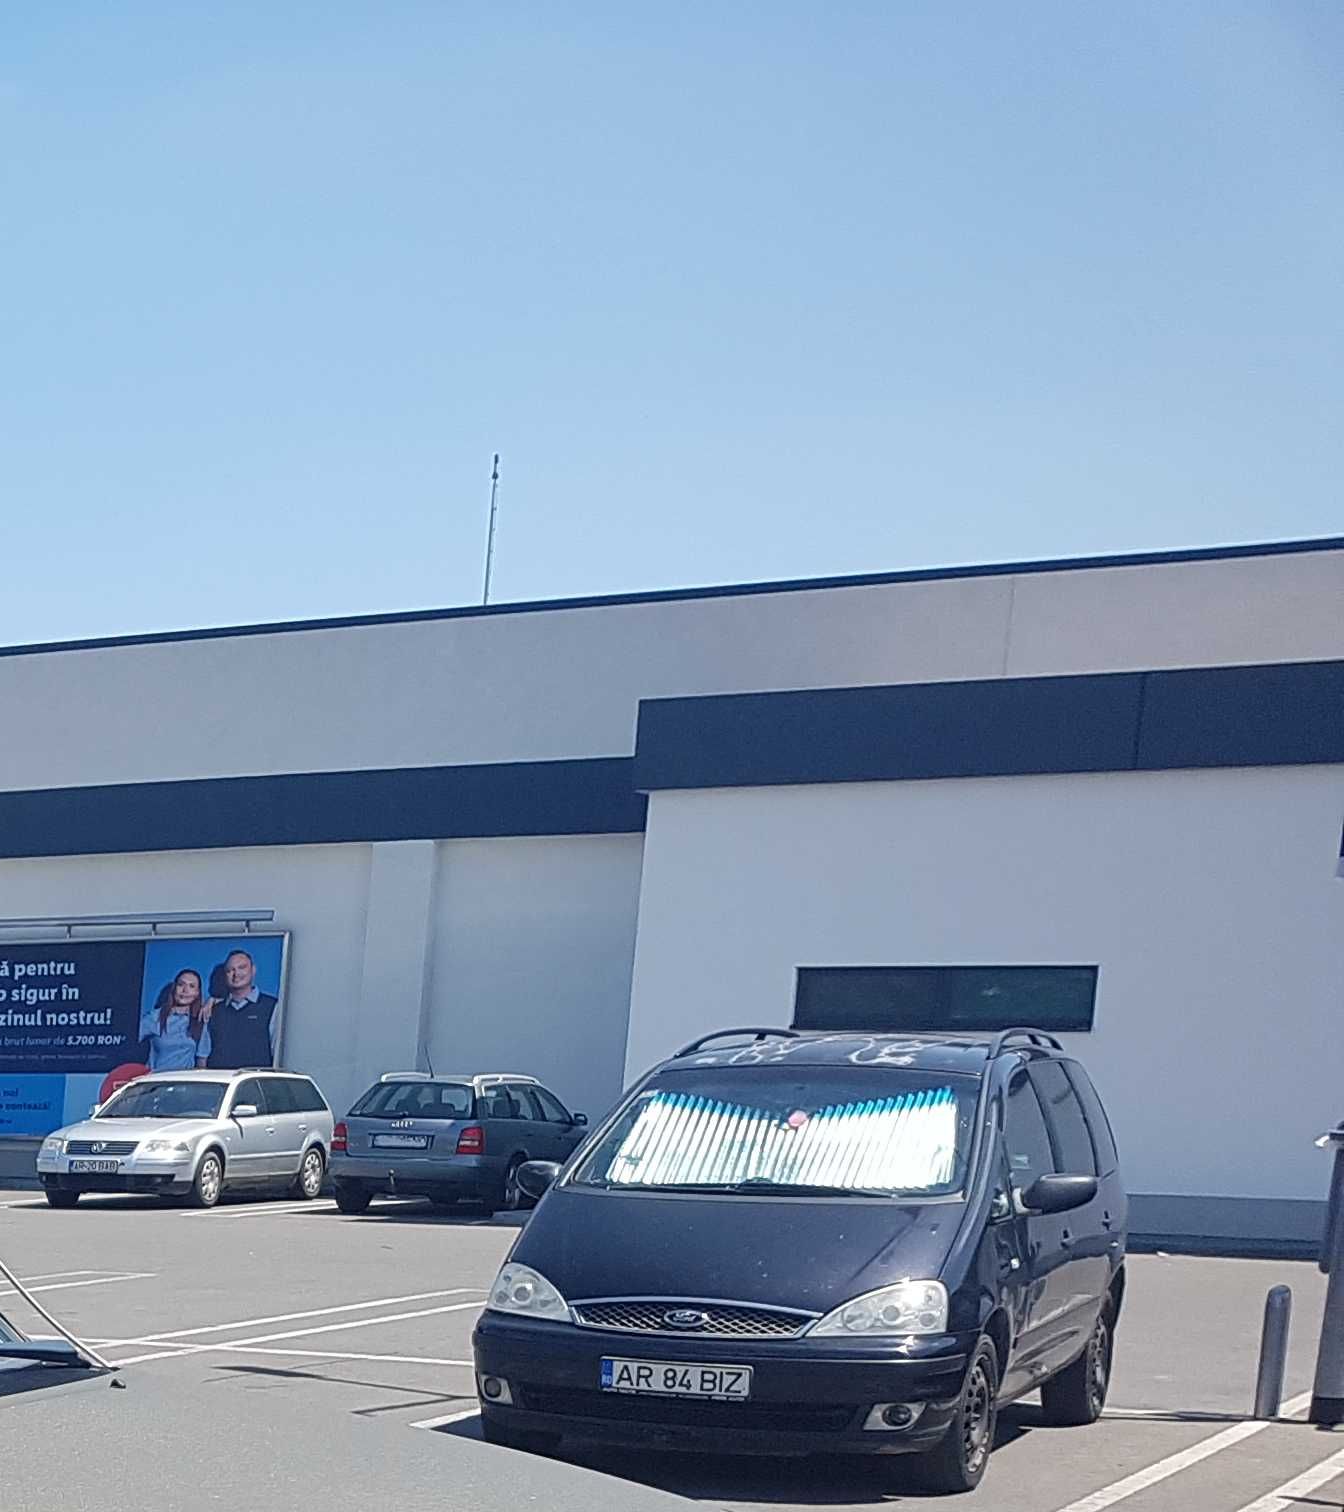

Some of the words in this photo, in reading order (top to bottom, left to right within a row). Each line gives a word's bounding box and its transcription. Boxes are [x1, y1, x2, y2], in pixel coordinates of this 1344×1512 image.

[14, 961, 76, 980] pentru
[10, 984, 59, 1005] sigur
[61, 984, 79, 1001] în
[46, 1008, 112, 1026] nostru!
[616, 1364, 654, 1388] AR
[663, 1368, 692, 1391] 84
[700, 1371, 743, 1394] BIZ
